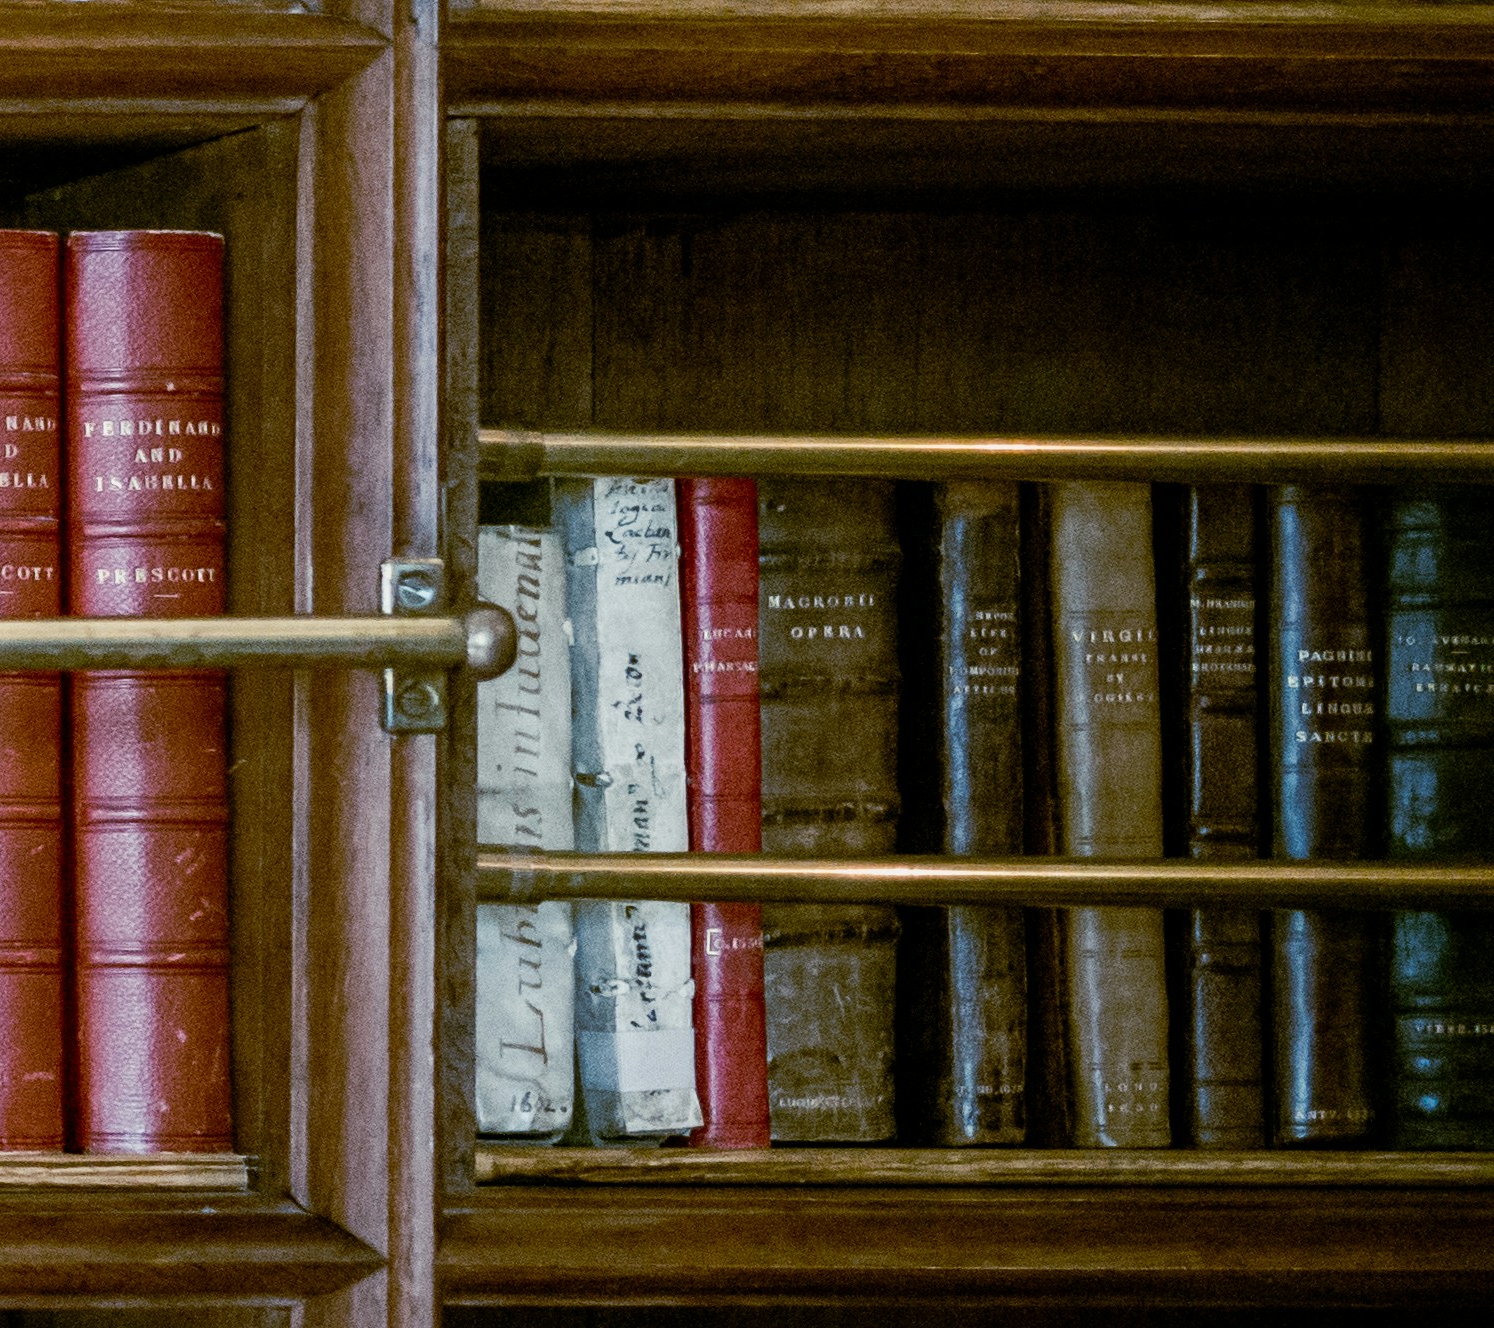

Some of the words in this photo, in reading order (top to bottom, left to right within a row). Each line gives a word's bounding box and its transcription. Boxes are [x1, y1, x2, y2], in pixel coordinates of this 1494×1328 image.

[84, 420, 221, 438] FERDINAND
[134, 448, 183, 464] AND
[95, 475, 214, 492] ISABELLA
[96, 566, 217, 584] PRESCOTT
[791, 625, 865, 638] OPERA
